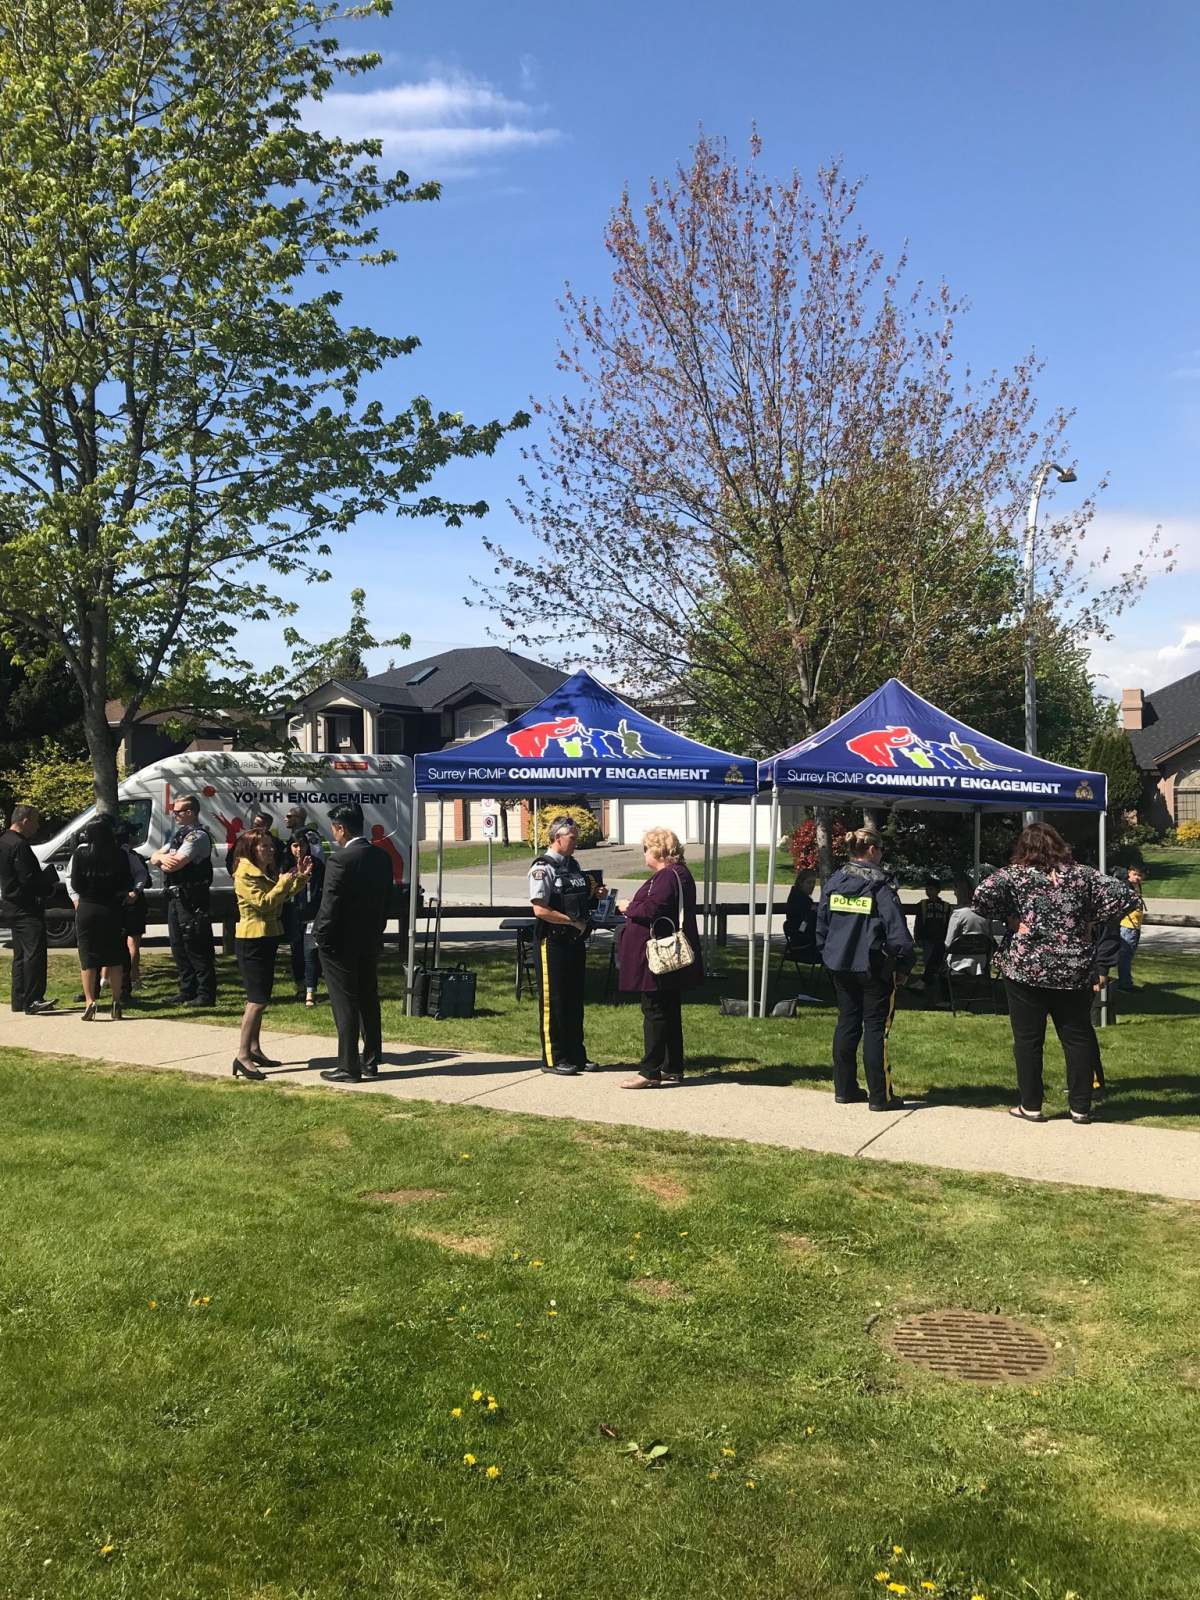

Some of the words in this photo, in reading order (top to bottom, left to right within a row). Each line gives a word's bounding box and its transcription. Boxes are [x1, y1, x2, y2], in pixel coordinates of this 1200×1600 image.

[428, 768, 466, 781] Surrey
[468, 767, 507, 780] RCMP
[508, 767, 602, 780] COMMUNITY
[605, 768, 710, 780] ENGAGEMENT
[233, 777, 262, 788] Surrey
[265, 778, 297, 788] RCMP
[787, 769, 824, 784] Surrey
[826, 771, 864, 784] RCMP
[866, 773, 957, 787] COMMUNITY
[960, 776, 1062, 794] ENGAGEMENT
[233, 792, 284, 804] YOUTH
[287, 792, 389, 805] ENGAGEMENT
